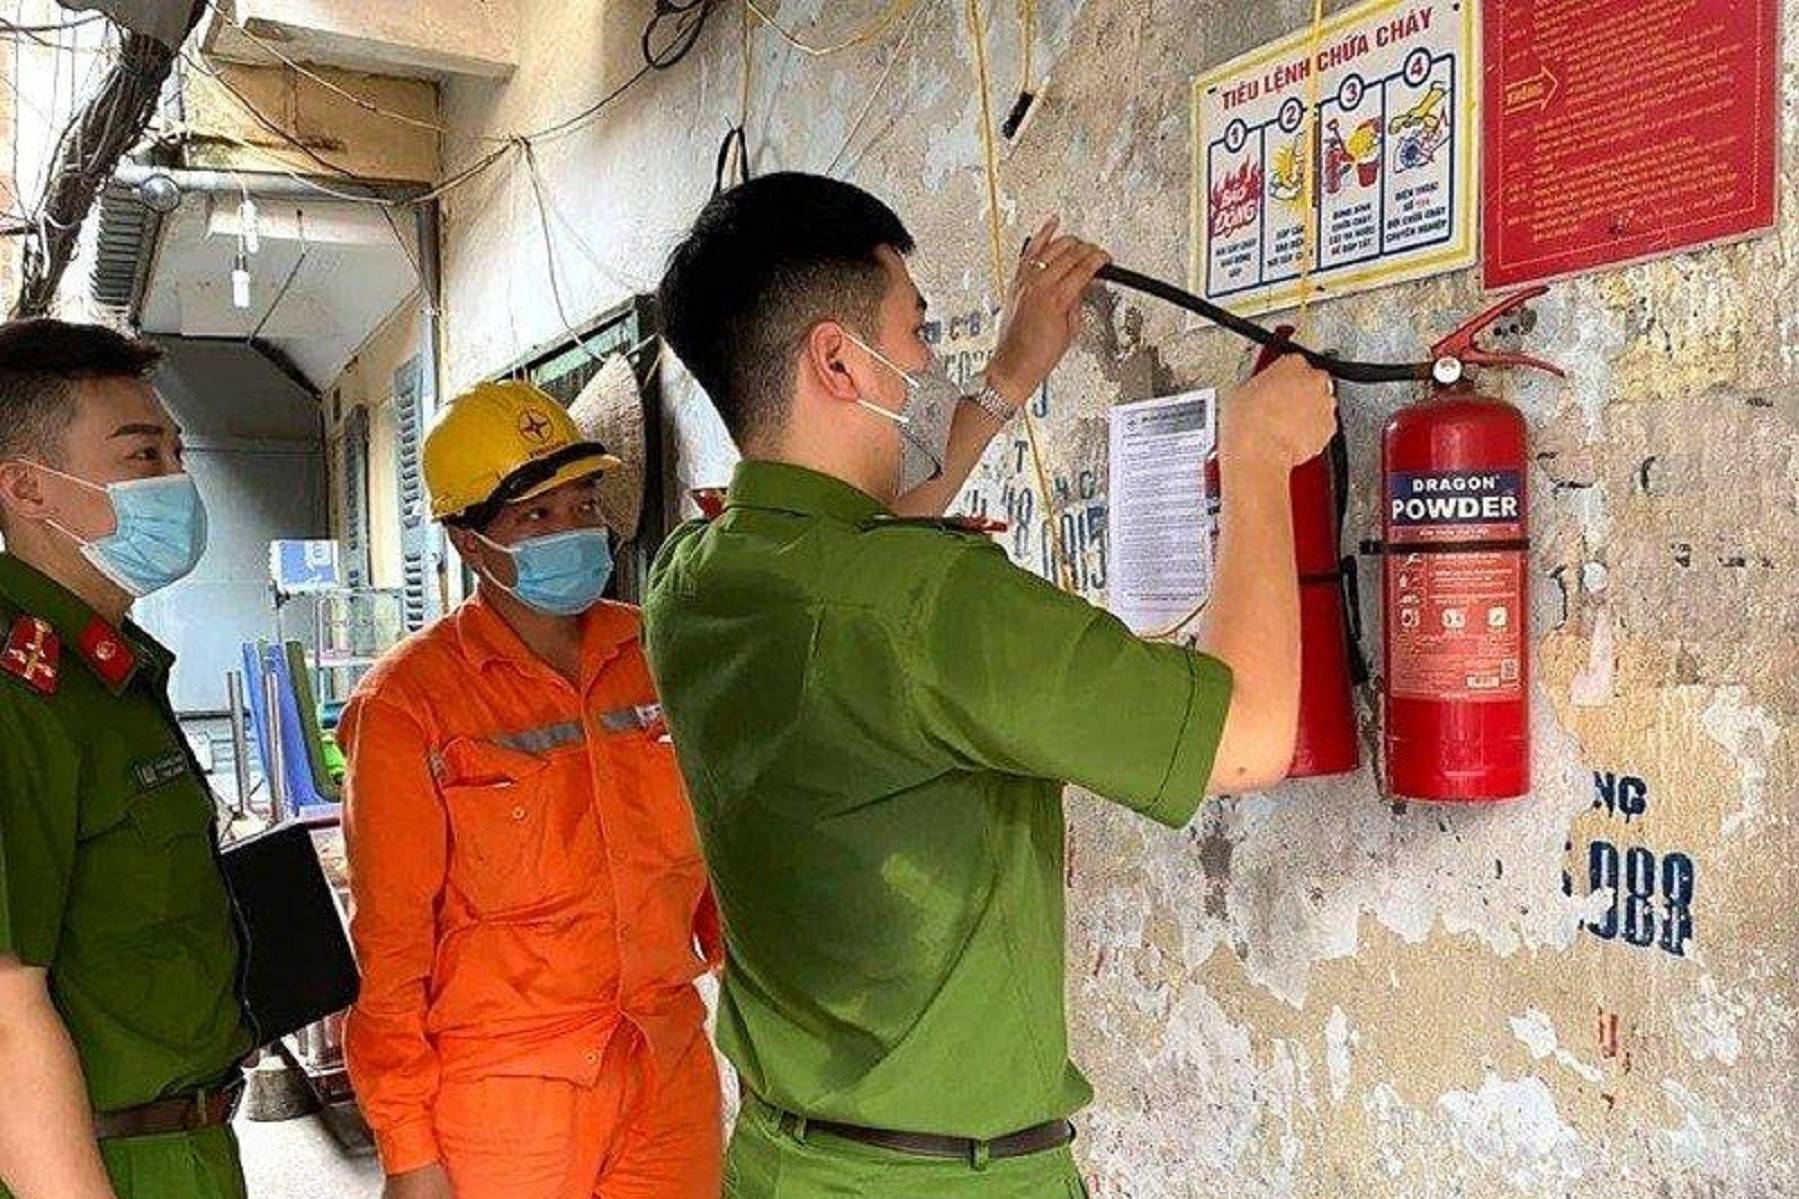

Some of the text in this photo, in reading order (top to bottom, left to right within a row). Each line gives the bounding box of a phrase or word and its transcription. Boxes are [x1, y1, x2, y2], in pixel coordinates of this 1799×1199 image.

[1264, 56, 1311, 95] LỆNH
[1376, 7, 1433, 48] CHÁY
[1410, 56, 1423, 76] 4
[1346, 85, 1357, 101] 3
[1285, 106, 1296, 122] 2
[1412, 476, 1495, 492] DRAGON
[1392, 496, 1518, 520] POWDER
